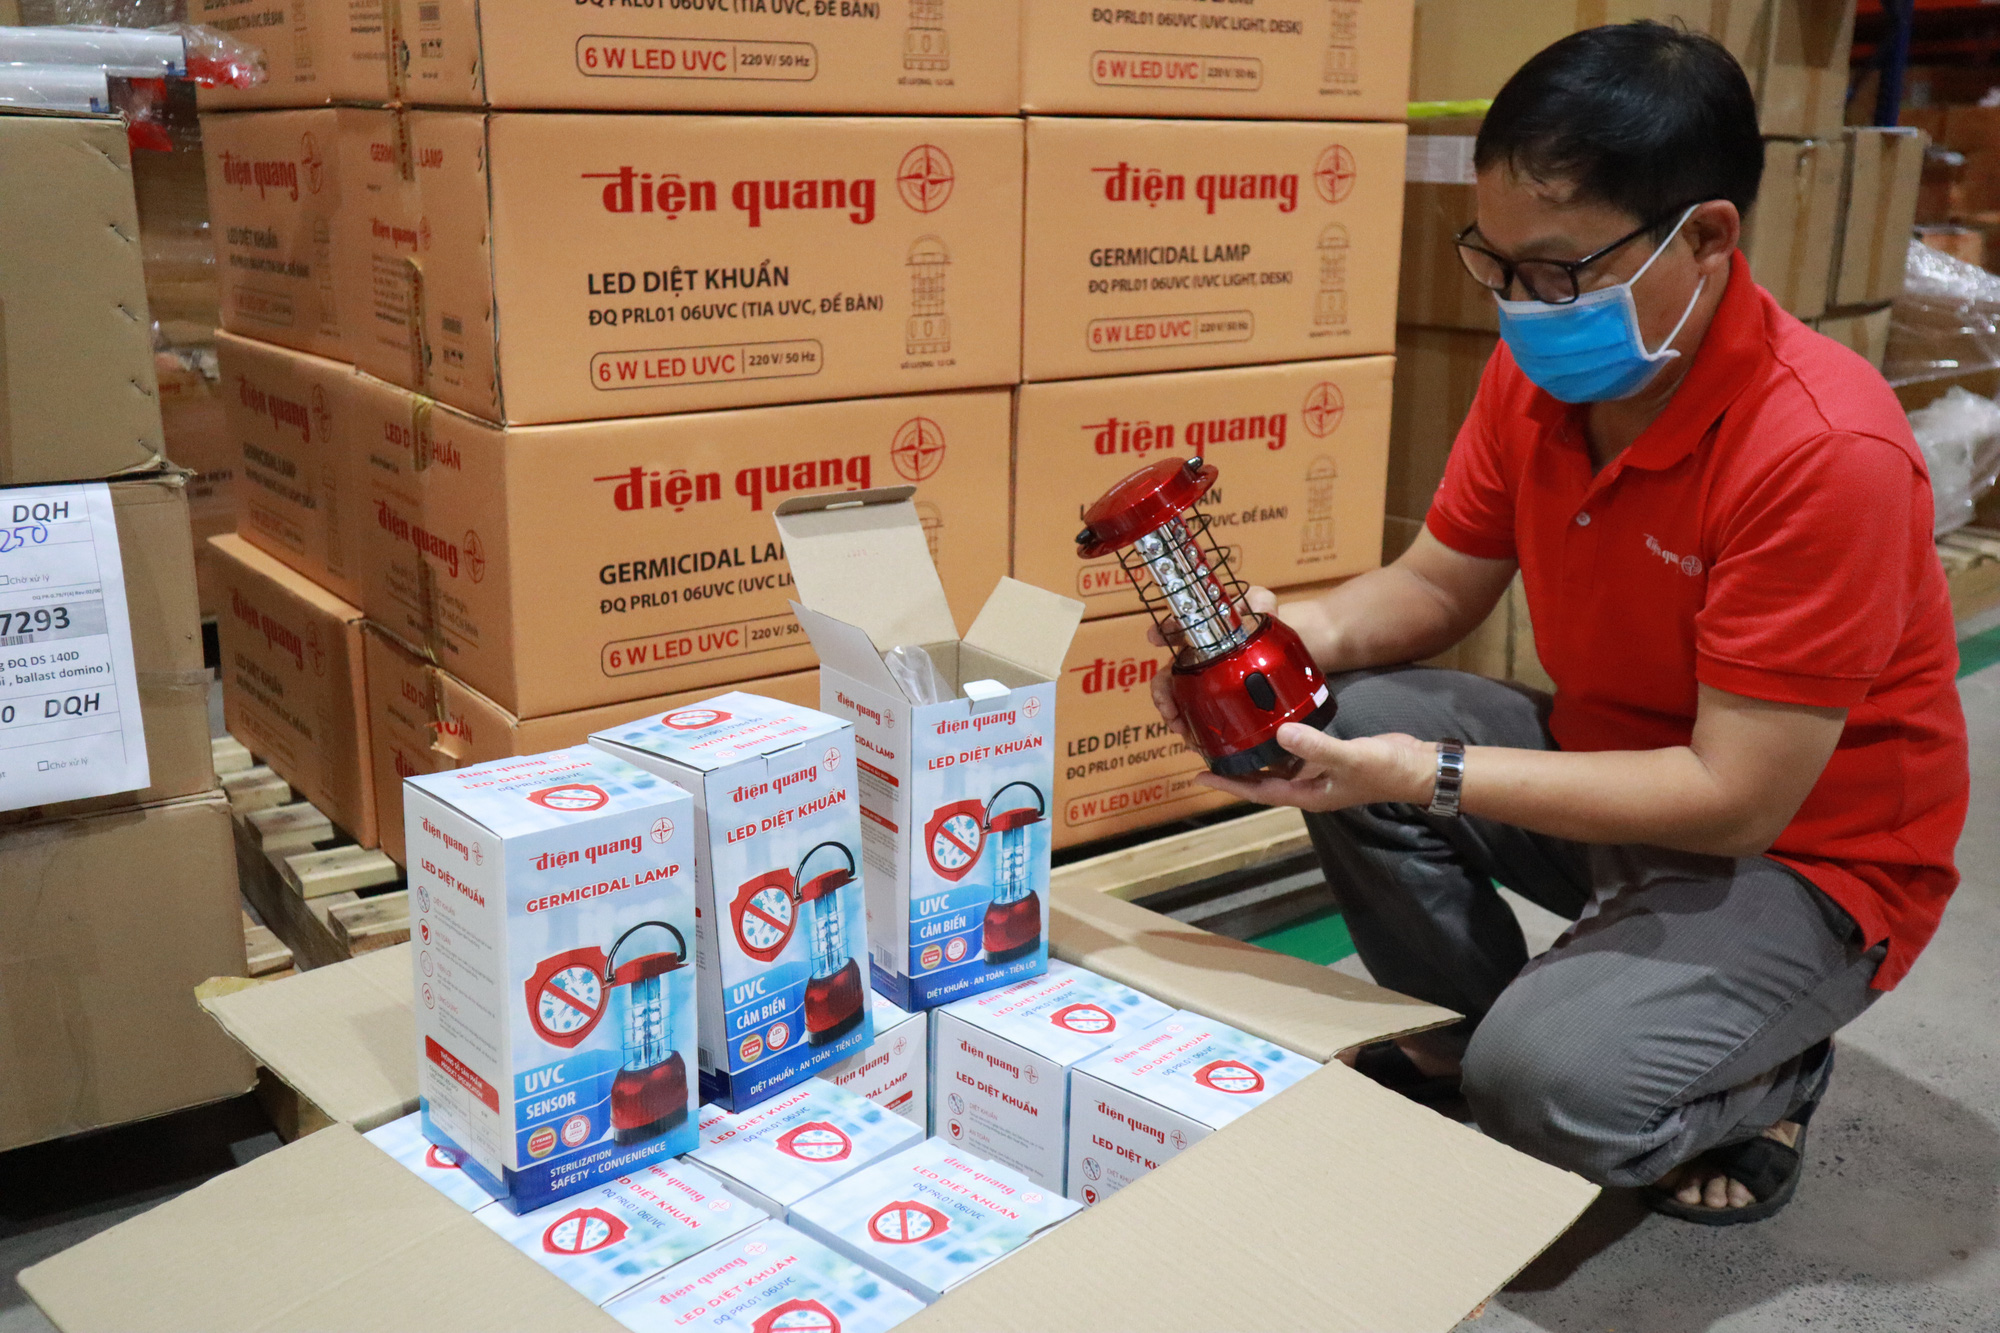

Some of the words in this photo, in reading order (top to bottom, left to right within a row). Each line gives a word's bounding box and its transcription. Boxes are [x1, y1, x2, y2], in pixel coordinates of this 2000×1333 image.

[1157, 12, 1197, 28] 06UVC
[603, 48, 626, 68] W
[632, 49, 676, 70] LED
[682, 50, 726, 71] UVC
[741, 54, 762, 66] 220
[1110, 60, 1128, 78] W
[1130, 60, 1162, 79] LED
[1166, 61, 1199, 80] UVC
[420, 147, 443, 169] LAMP
[254, 162, 298, 202] quang
[581, 165, 717, 220] điện
[731, 178, 876, 227] quang
[1196, 173, 1299, 214] quang
[1090, 246, 1199, 267] GERMICIDAL
[1204, 244, 1251, 263] LAMP
[588, 271, 636, 295] LED
[643, 266, 698, 297] DIỆT
[705, 259, 789, 290] KHUẨN
[1112, 278, 1147, 292] PRL01
[1152, 276, 1190, 290] 06UVC
[589, 308, 617, 326] ĐQ
[622, 306, 674, 324] PRL01
[681, 302, 738, 322] 06UVC
[742, 300, 774, 318] (TIA
[846, 294, 883, 312] BÀN)
[1106, 325, 1122, 343] W
[1125, 323, 1155, 341] LED
[1159, 320, 1192, 339] UVC
[599, 362, 610, 382] 6
[617, 362, 638, 380] W
[644, 358, 686, 379] LED
[693, 354, 735, 376] UVC
[749, 355, 770, 367] 220
[786, 353, 799, 364] 50
[802, 352, 815, 363] Hz
[385, 420, 401, 446] LED
[1081, 417, 1175, 458] điện
[1185, 413, 1288, 457] quang
[594, 466, 721, 512] điện
[12, 501, 68, 522] DQH
[412, 525, 458, 578] quang
[599, 546, 745, 585] GERMICIDAL
[600, 598, 627, 615] ĐQ
[630, 590, 679, 610] PRL01
[683, 580, 734, 602] 06UVC
[739, 575, 774, 595] (UVC
[1083, 574, 1091, 590] 6
[1095, 572, 1110, 588] W
[0, 607, 70, 636] 7293
[8, 657, 28, 668] ĐQ
[30, 656, 46, 666] DS
[50, 651, 79, 663] 140D
[609, 651, 621, 668] 6
[626, 645, 647, 666] W
[652, 638, 692, 662] LED
[698, 629, 739, 653] UVC
[752, 628, 771, 641] 220
[16, 670, 55, 684] ballast
[59, 664, 103, 678] domino
[44, 693, 100, 718] DQH
[856, 702, 881, 726] quang
[931, 718, 969, 735] điện
[973, 710, 1016, 732] quang
[875, 744, 895, 760] LAMP
[928, 756, 955, 770] LED
[959, 746, 990, 765] DIỆT
[994, 734, 1043, 756] KHUẨN
[1068, 736, 1099, 757] LED
[1104, 725, 1142, 749] DIỆT
[1067, 765, 1086, 780] ĐQ
[1089, 757, 1124, 774] PRL01
[1128, 746, 1167, 765] 06UVC
[463, 781, 494, 790] LED
[727, 783, 768, 803] điện
[772, 765, 817, 794] quang
[727, 824, 757, 844] LED
[761, 807, 794, 832] DIỆT
[798, 788, 846, 818] KHUẨN
[1070, 806, 1078, 820] 6
[1082, 801, 1097, 817] W
[1100, 793, 1129, 813] LED
[1133, 785, 1163, 805] UVC
[443, 833, 468, 861] quang
[529, 851, 579, 871] điện
[585, 835, 642, 864] quang
[421, 858, 436, 875] LED
[438, 871, 455, 887] DIỆT
[457, 881, 485, 908] KHUẨN
[526, 877, 630, 914] GERMICIDAL
[634, 864, 679, 885] LAMP
[920, 894, 949, 916] UVC
[920, 922, 941, 939] CẢM
[944, 914, 966, 933] BIẾN
[734, 977, 766, 1005] UVC
[927, 988, 942, 999] DIỆT
[944, 978, 969, 994] KHUẨN
[974, 976, 984, 985] AN
[985, 970, 1005, 982] TOÀN
[737, 1010, 759, 1030] CẢM
[762, 997, 786, 1020] BIẾN
[993, 1006, 1014, 1017] LED
[750, 1080, 767, 1095] DIỆT
[768, 1067, 794, 1086] KHUẨN
[800, 1063, 810, 1071] AN
[811, 1050, 830, 1064] TOÀN
[859, 1052, 889, 1077] quang
[957, 1038, 984, 1059] điện
[986, 1053, 1019, 1079] quang
[1132, 1064, 1153, 1076] LED
[525, 1064, 564, 1093] UVC
[885, 1072, 907, 1091] LAMP
[526, 1091, 576, 1120] SENSOR
[956, 1071, 974, 1086] LED
[977, 1080, 1000, 1098] DIỆT
[1002, 1093, 1038, 1116] KHUẨN
[570, 1121, 581, 1130] LED
[1094, 1100, 1124, 1122] điện
[1127, 1117, 1165, 1144] quang
[710, 1130, 736, 1144] LED
[1092, 1134, 1113, 1150] LED
[1117, 1146, 1142, 1163] DIỆT
[550, 1149, 612, 1178] STERILIZATION
[550, 1168, 589, 1191] SAFETY
[598, 1141, 666, 1174] CONVENIENCE
[913, 1165, 939, 1180] LED
[665, 1177, 706, 1202] quang
[974, 1172, 1016, 1195] quang
[697, 1257, 748, 1284] quang
[674, 1307, 706, 1326] LED
[707, 1285, 743, 1308] DIỆT
[744, 1255, 798, 1287] KHUẨN
